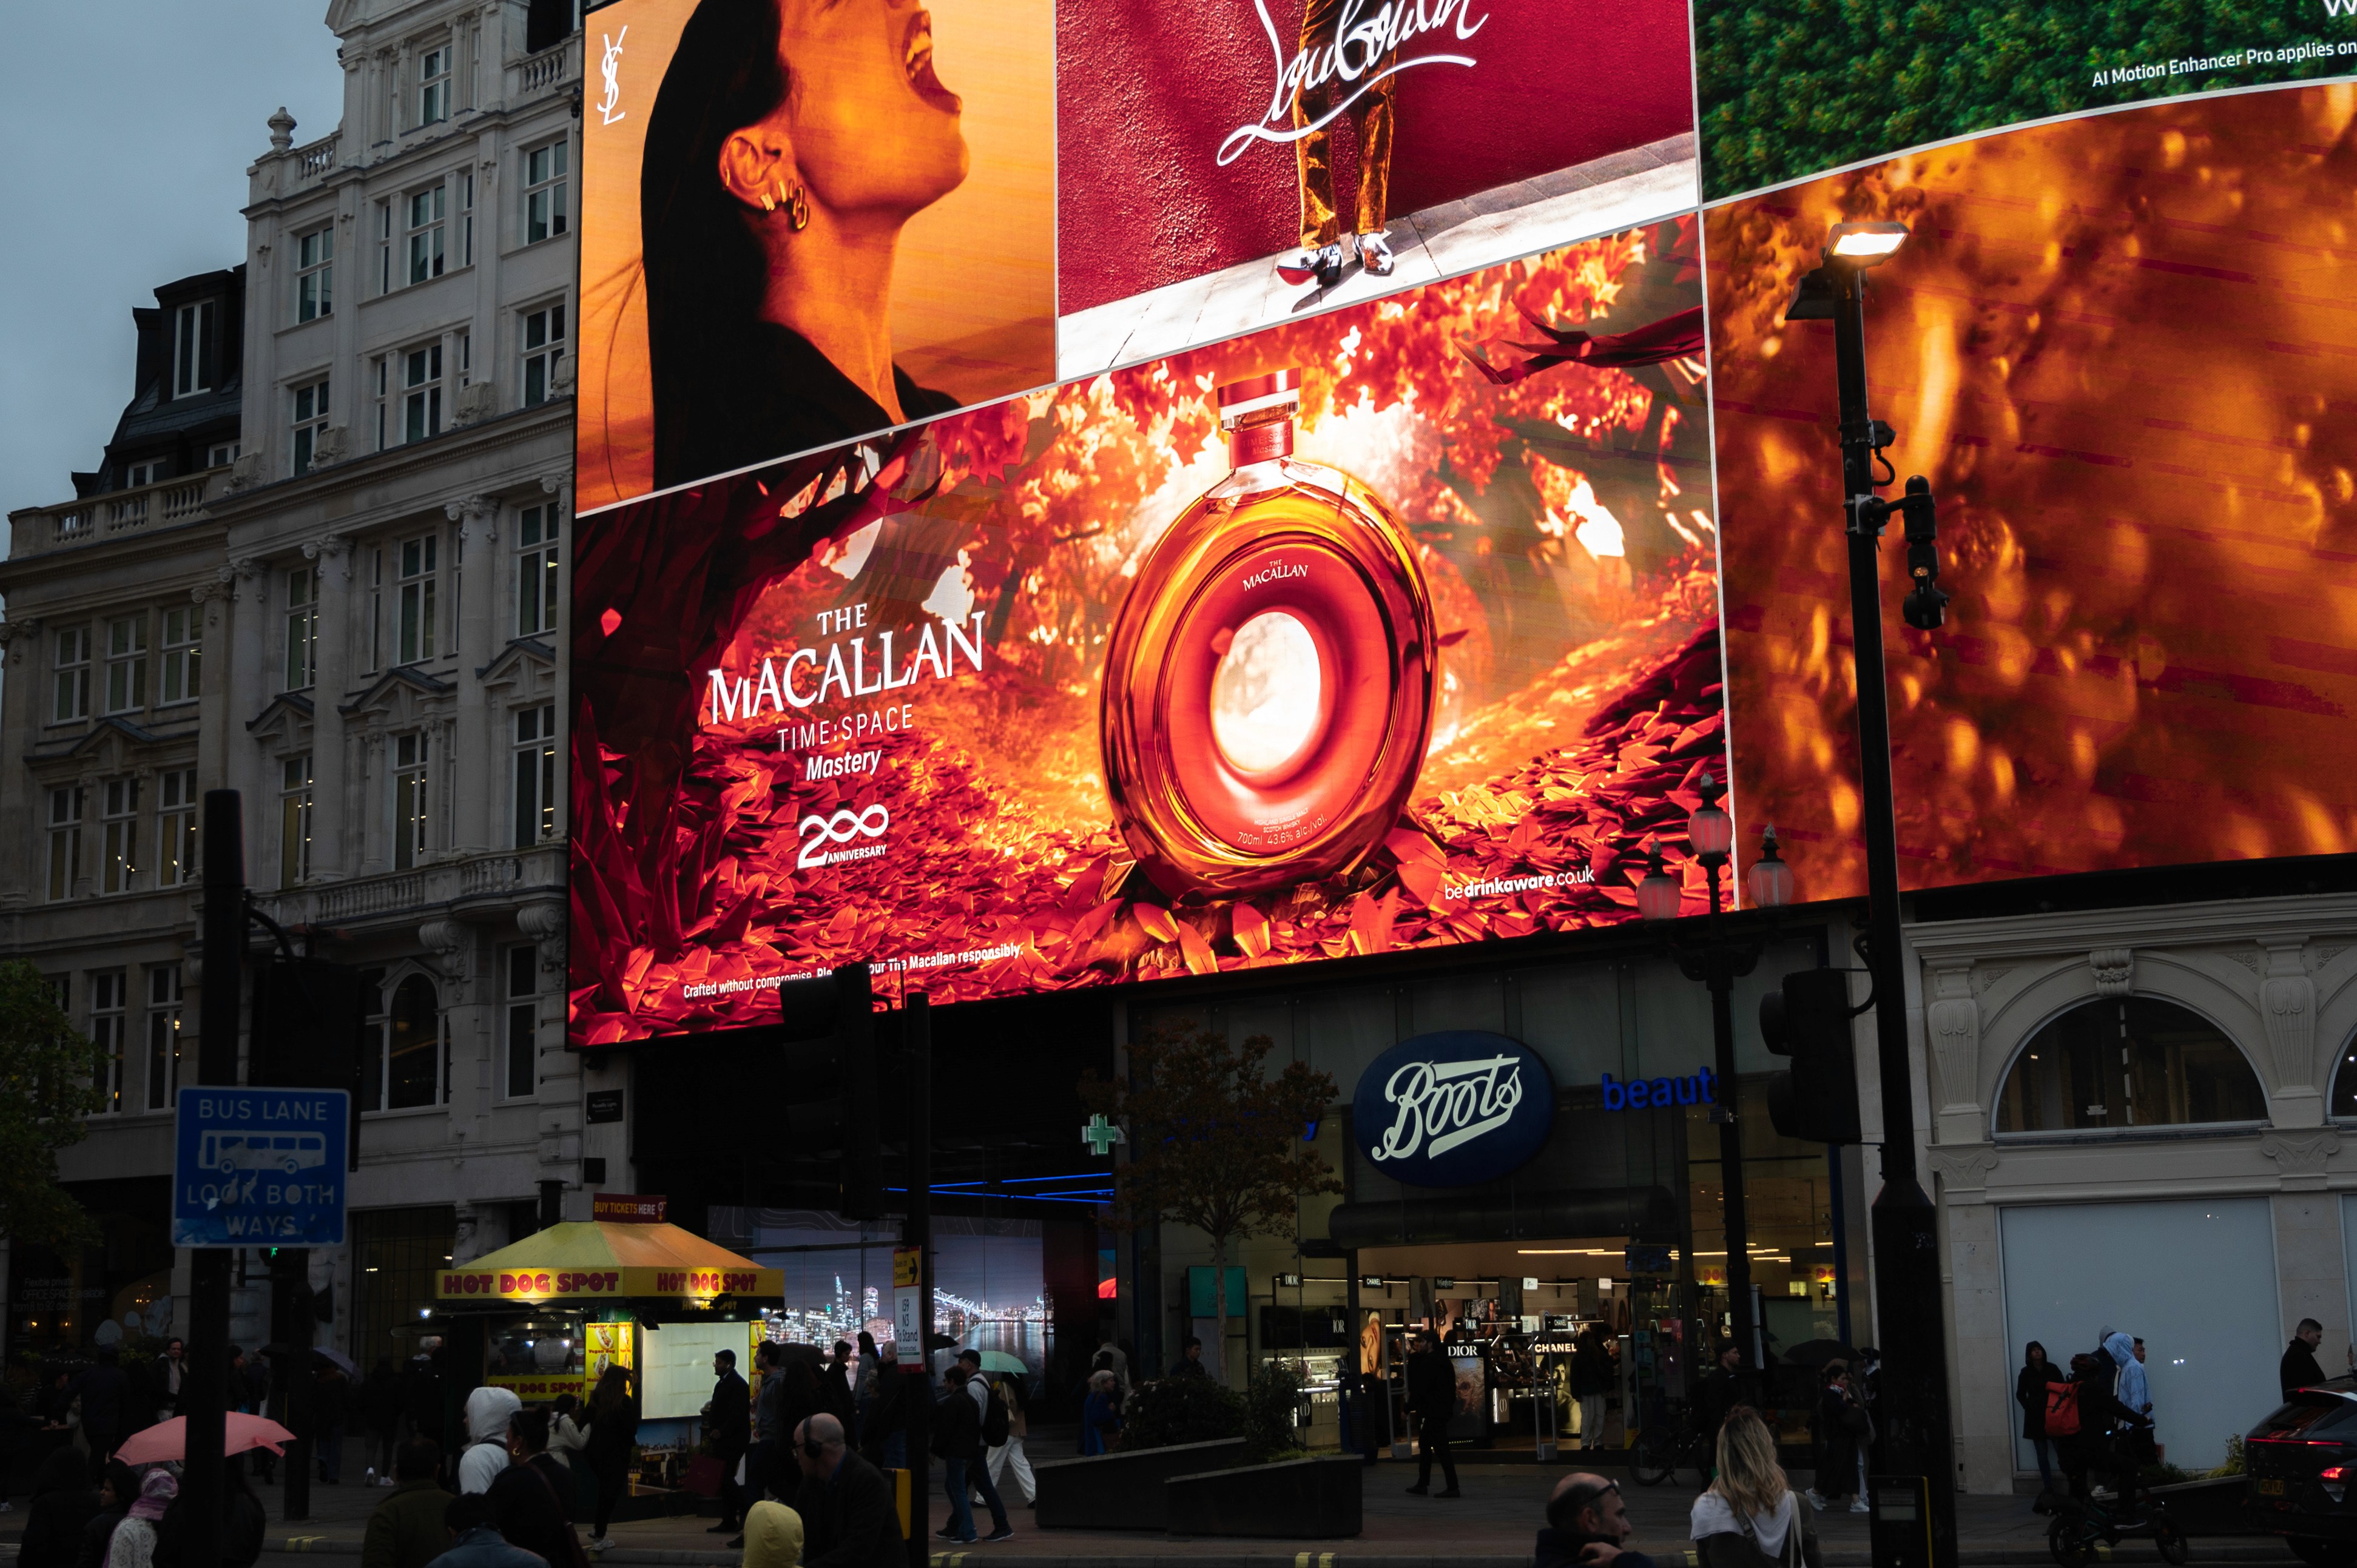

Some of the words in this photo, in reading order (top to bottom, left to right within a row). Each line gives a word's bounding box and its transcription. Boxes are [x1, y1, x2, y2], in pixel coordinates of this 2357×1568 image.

[2092, 69, 2108, 87] AI
[2112, 61, 2166, 84] Motion
[2170, 54, 2243, 75] Enhancer
[2247, 49, 2273, 65] Pro
[2276, 42, 2335, 63] applies
[1243, 564, 1308, 591] MACALLAN
[817, 602, 868, 636] THE
[709, 610, 985, 725] MACALLAN
[777, 704, 912, 752] TIME:SPACE
[806, 750, 882, 781] Mastery
[797, 804, 889, 869] 200
[1238, 832, 1262, 845] 700ml
[1267, 830, 1293, 844] 43.6%
[828, 844, 887, 864] ANNIVERSARY
[684, 981, 717, 998] Crafted
[719, 977, 754, 994] without
[888, 957, 907, 971] The
[909, 952, 955, 969] Macallan
[958, 942, 1023, 964] responsibly.
[1602, 1066, 1718, 1111] beaut
[198, 1099, 252, 1119] BUS
[263, 1100, 328, 1121] LANE
[1372, 1054, 1522, 1161] Boots
[187, 1184, 256, 1205] LOOK
[266, 1184, 334, 1205] BOTH
[594, 1202, 609, 1213] BUY
[610, 1202, 637, 1214] TICKETS
[638, 1203, 655, 1215] HERE
[225, 1216, 296, 1236] WAYS
[24, 1277, 50, 1287] Flexible
[52, 1276, 74, 1288] private
[443, 1274, 493, 1294] HOT
[500, 1273, 550, 1293] DOG
[556, 1273, 619, 1292] SPOT
[657, 1273, 686, 1291] HOT
[690, 1273, 719, 1291] DOG
[723, 1273, 757, 1292] SPOT
[1285, 1275, 1298, 1285] DIOR
[22, 1289, 48, 1300] OFFICE
[50, 1288, 76, 1299] SPACE
[76, 1287, 106, 1298] available
[13, 1302, 29, 1312] from
[36, 1302, 44, 1311] to
[45, 1301, 55, 1311] 92
[56, 1301, 78, 1310] desks
[718, 1300, 737, 1310] POT
[902, 1313, 909, 1327] N3
[897, 1329, 902, 1342] To
[903, 1328, 918, 1342] Stand
[1448, 1345, 1478, 1357] DIOR
[1534, 1343, 1577, 1353] CHANEL
[519, 1382, 547, 1394] DOG
[550, 1382, 584, 1393] SPOT
